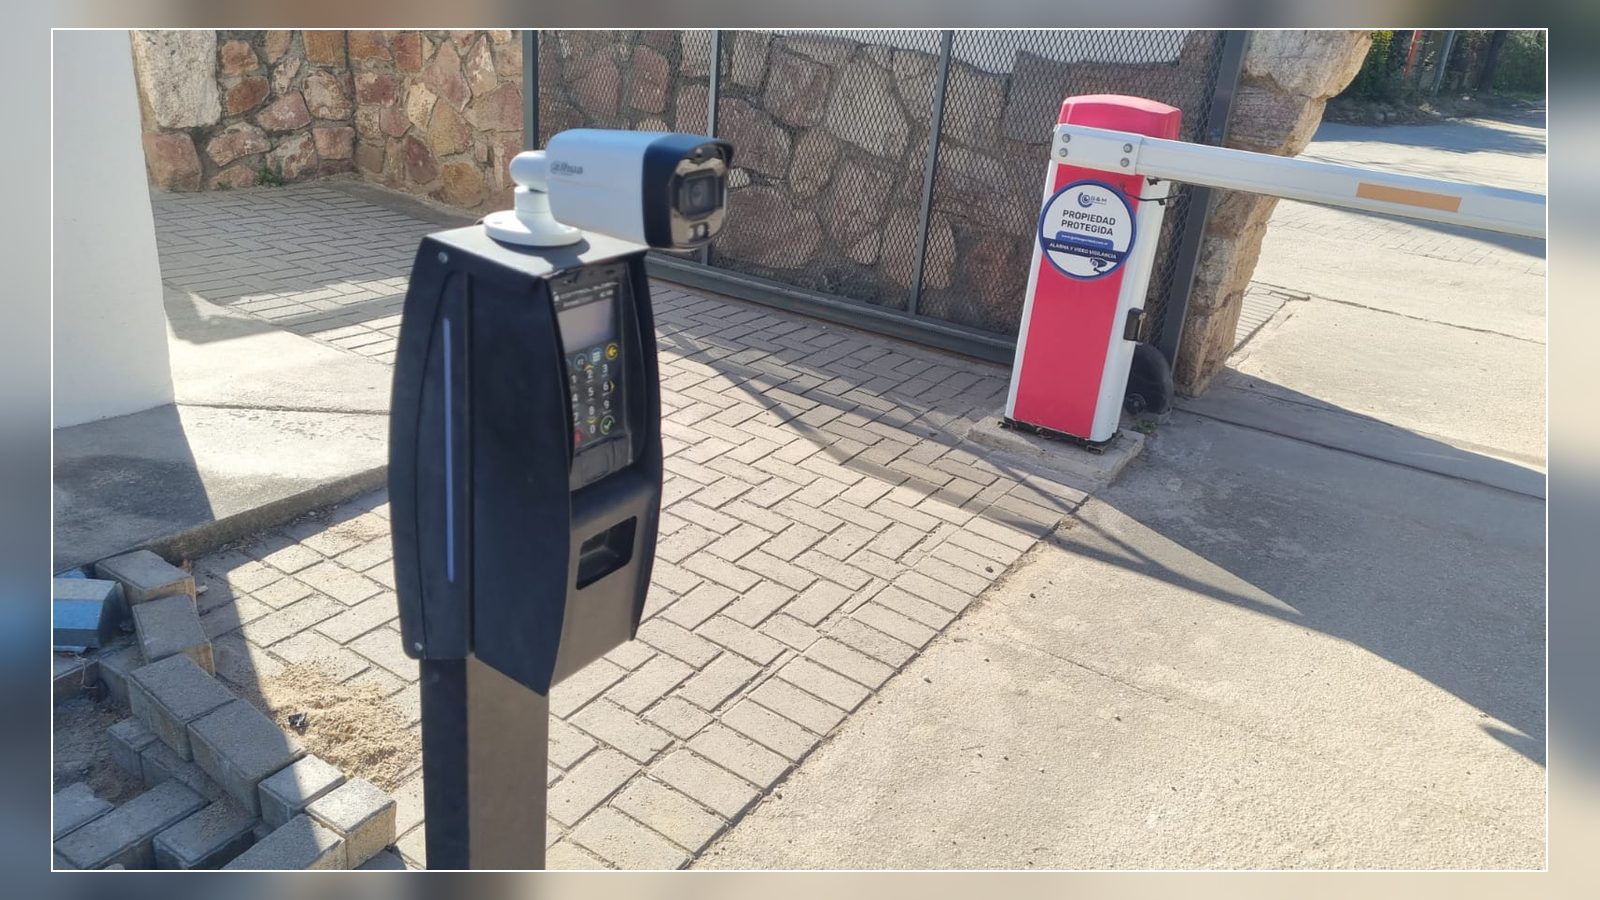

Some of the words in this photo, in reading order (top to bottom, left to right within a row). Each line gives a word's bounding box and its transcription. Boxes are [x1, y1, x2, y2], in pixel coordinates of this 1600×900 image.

[1062, 210, 1116, 225] PROPIEDAD
[1061, 219, 1114, 236] PROTEGIDA
[1089, 250, 1117, 259] VIGILANCIA
